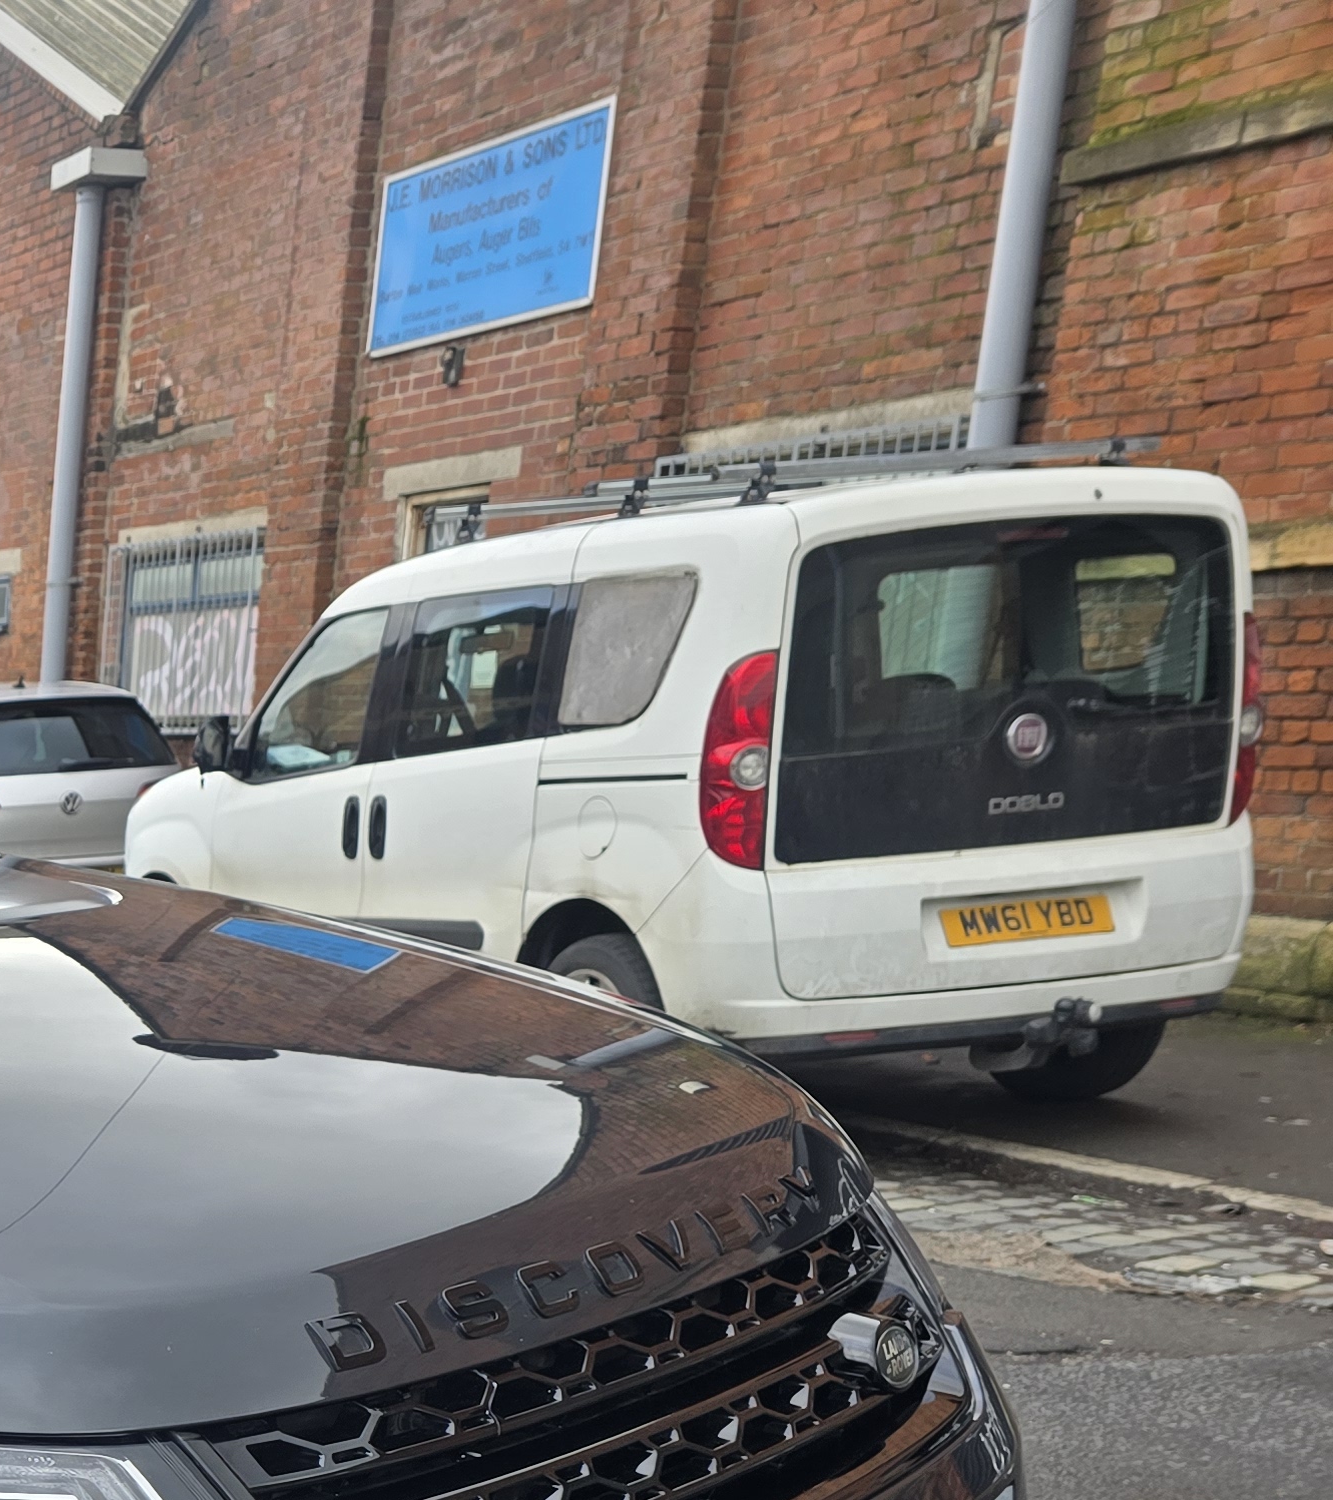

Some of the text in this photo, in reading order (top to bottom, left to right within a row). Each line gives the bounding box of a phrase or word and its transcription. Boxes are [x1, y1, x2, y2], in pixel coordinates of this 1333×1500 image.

[419, 154, 498, 204] MORRISON
[522, 130, 569, 169] SONS
[988, 792, 1065, 815] DOBLO
[959, 898, 1095, 937] MW61 YBD
[304, 1166, 821, 1371] DISCOVERY
